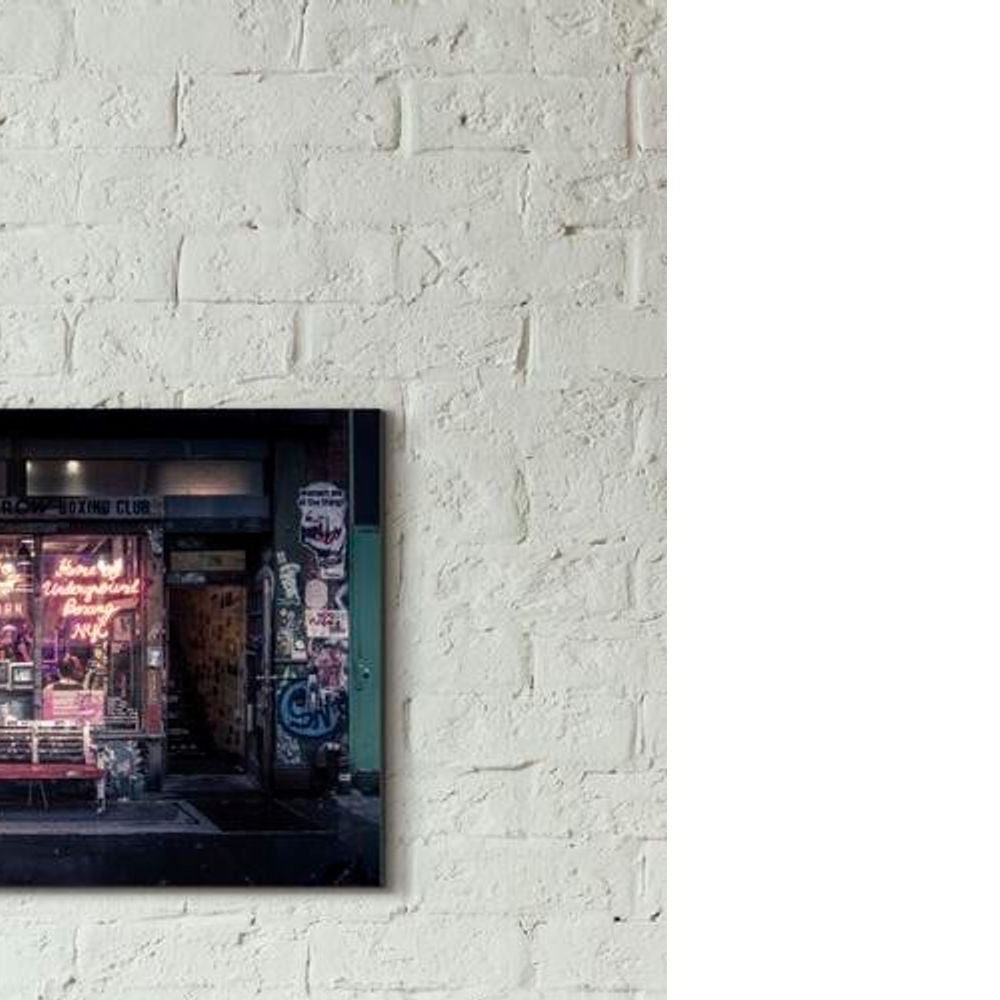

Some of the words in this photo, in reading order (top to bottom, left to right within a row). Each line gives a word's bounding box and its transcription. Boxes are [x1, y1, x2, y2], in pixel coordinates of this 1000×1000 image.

[116, 499, 151, 514] CLUB
[41, 578, 140, 603] Underground
[69, 621, 109, 643] NYC
